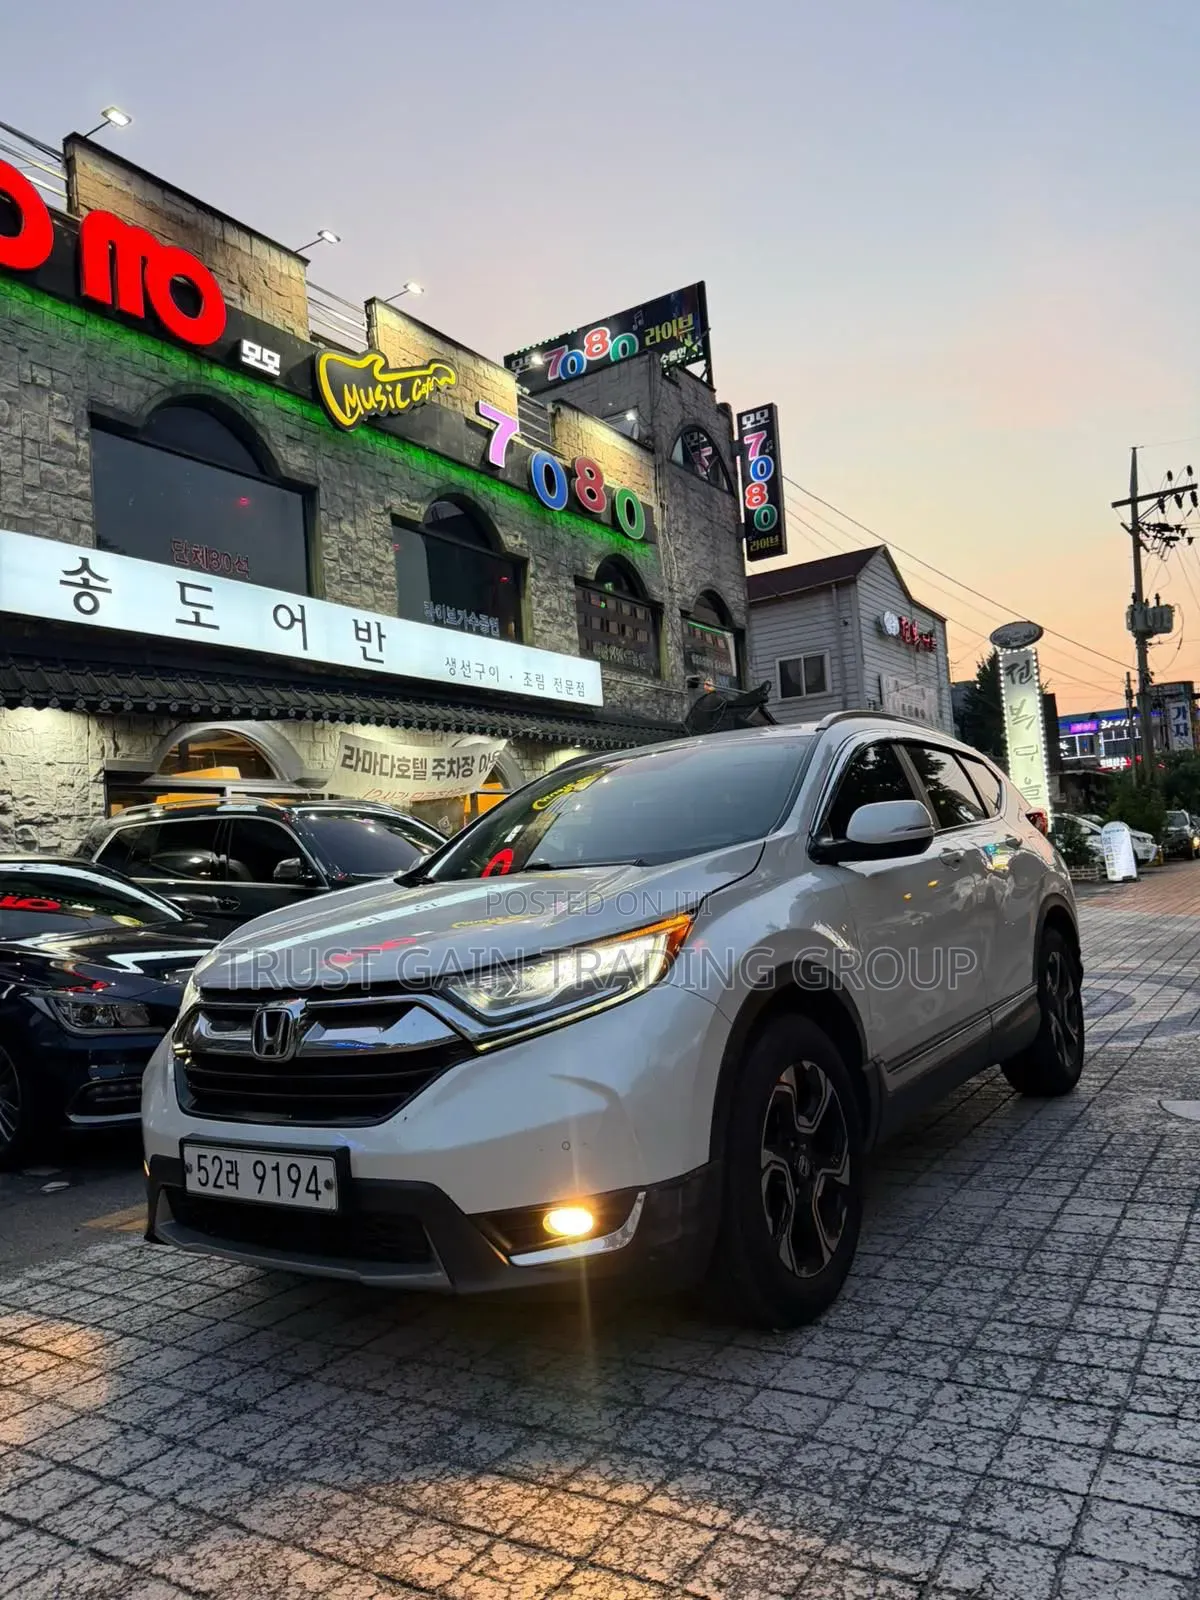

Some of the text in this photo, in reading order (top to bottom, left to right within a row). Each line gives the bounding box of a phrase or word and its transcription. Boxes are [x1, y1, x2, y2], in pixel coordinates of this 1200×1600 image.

[241, 339, 280, 377] 모모
[543, 327, 640, 381] 7080
[741, 409, 770, 431] 모모
[479, 401, 646, 540] 7080
[744, 430, 778, 532] 7080
[444, 656, 586, 698] 생선구이 조림 전문점
[340, 744, 428, 781] 라마다호텔
[431, 756, 475, 781] 주차장
[196, 1154, 322, 1201] 52라 9194
